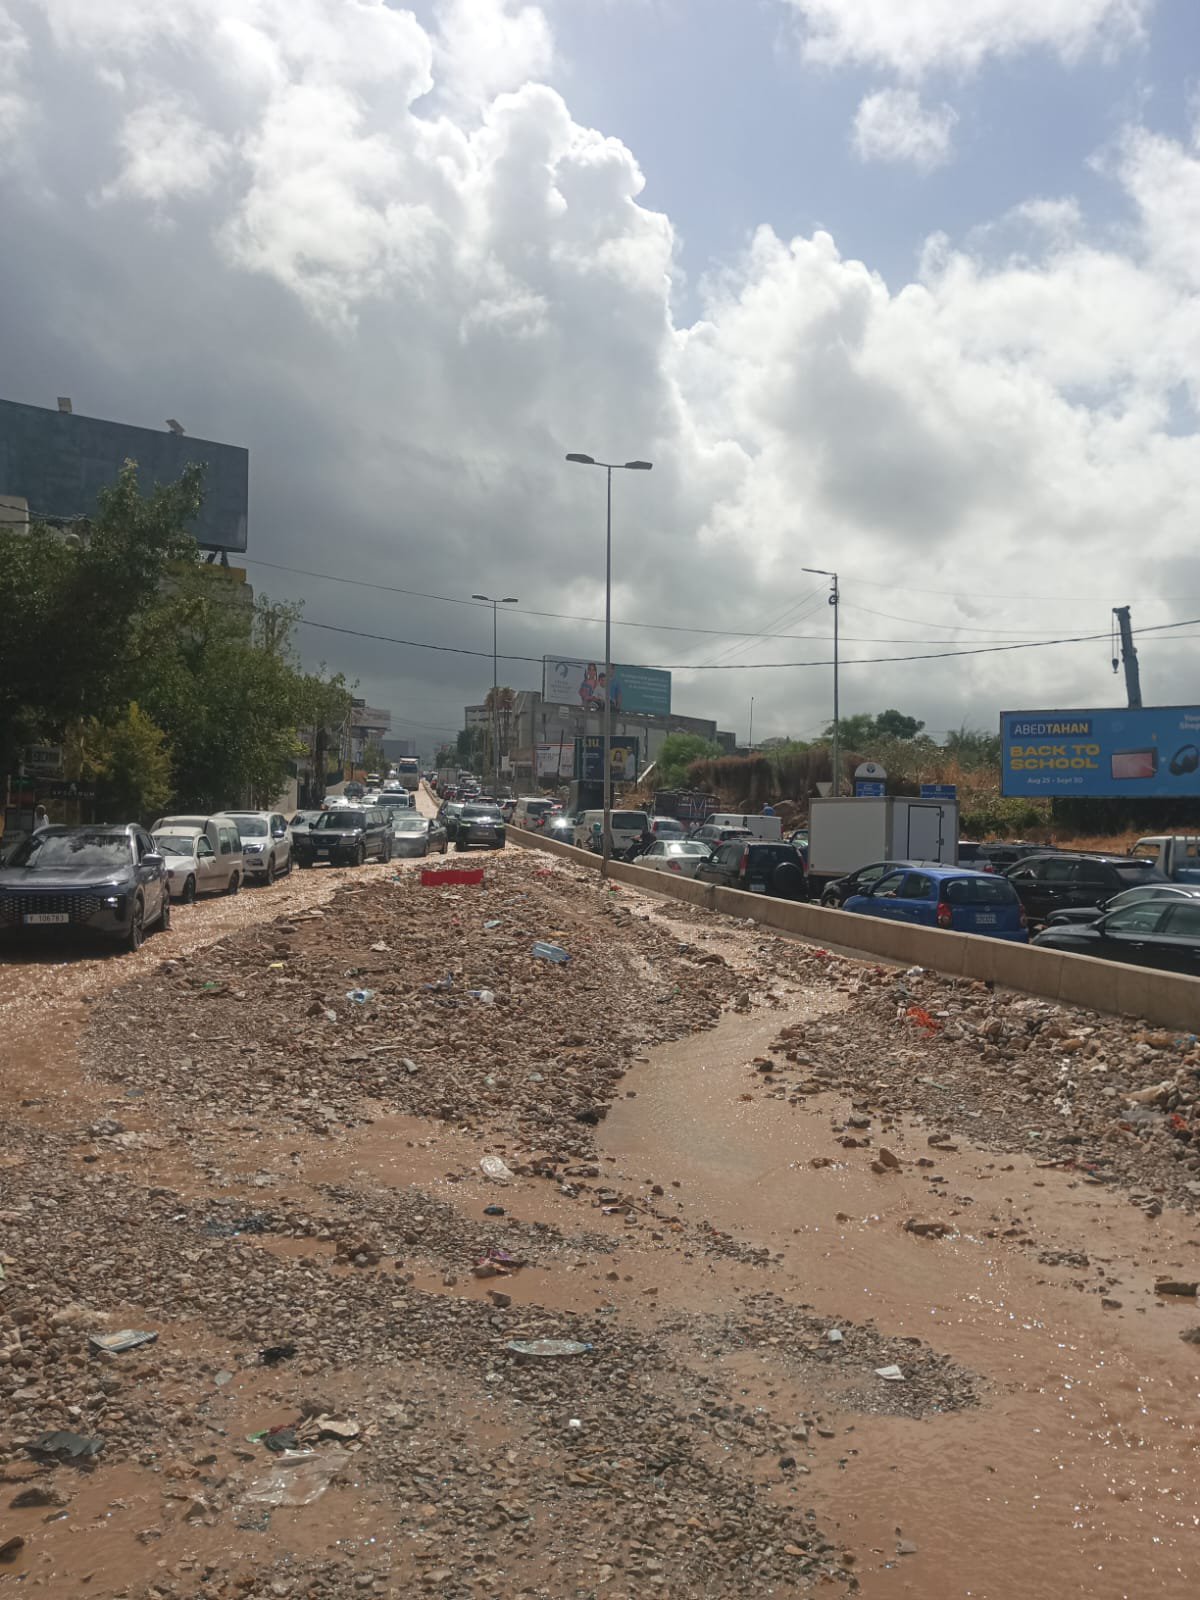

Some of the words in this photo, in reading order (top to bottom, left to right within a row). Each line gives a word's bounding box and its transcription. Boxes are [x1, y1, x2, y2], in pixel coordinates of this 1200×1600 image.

[1014, 723, 1089, 735] ABEDTAHAN
[1010, 745, 1067, 757] BACK
[1072, 744, 1100, 755] TO
[1010, 757, 1099, 770] SCHOOL
